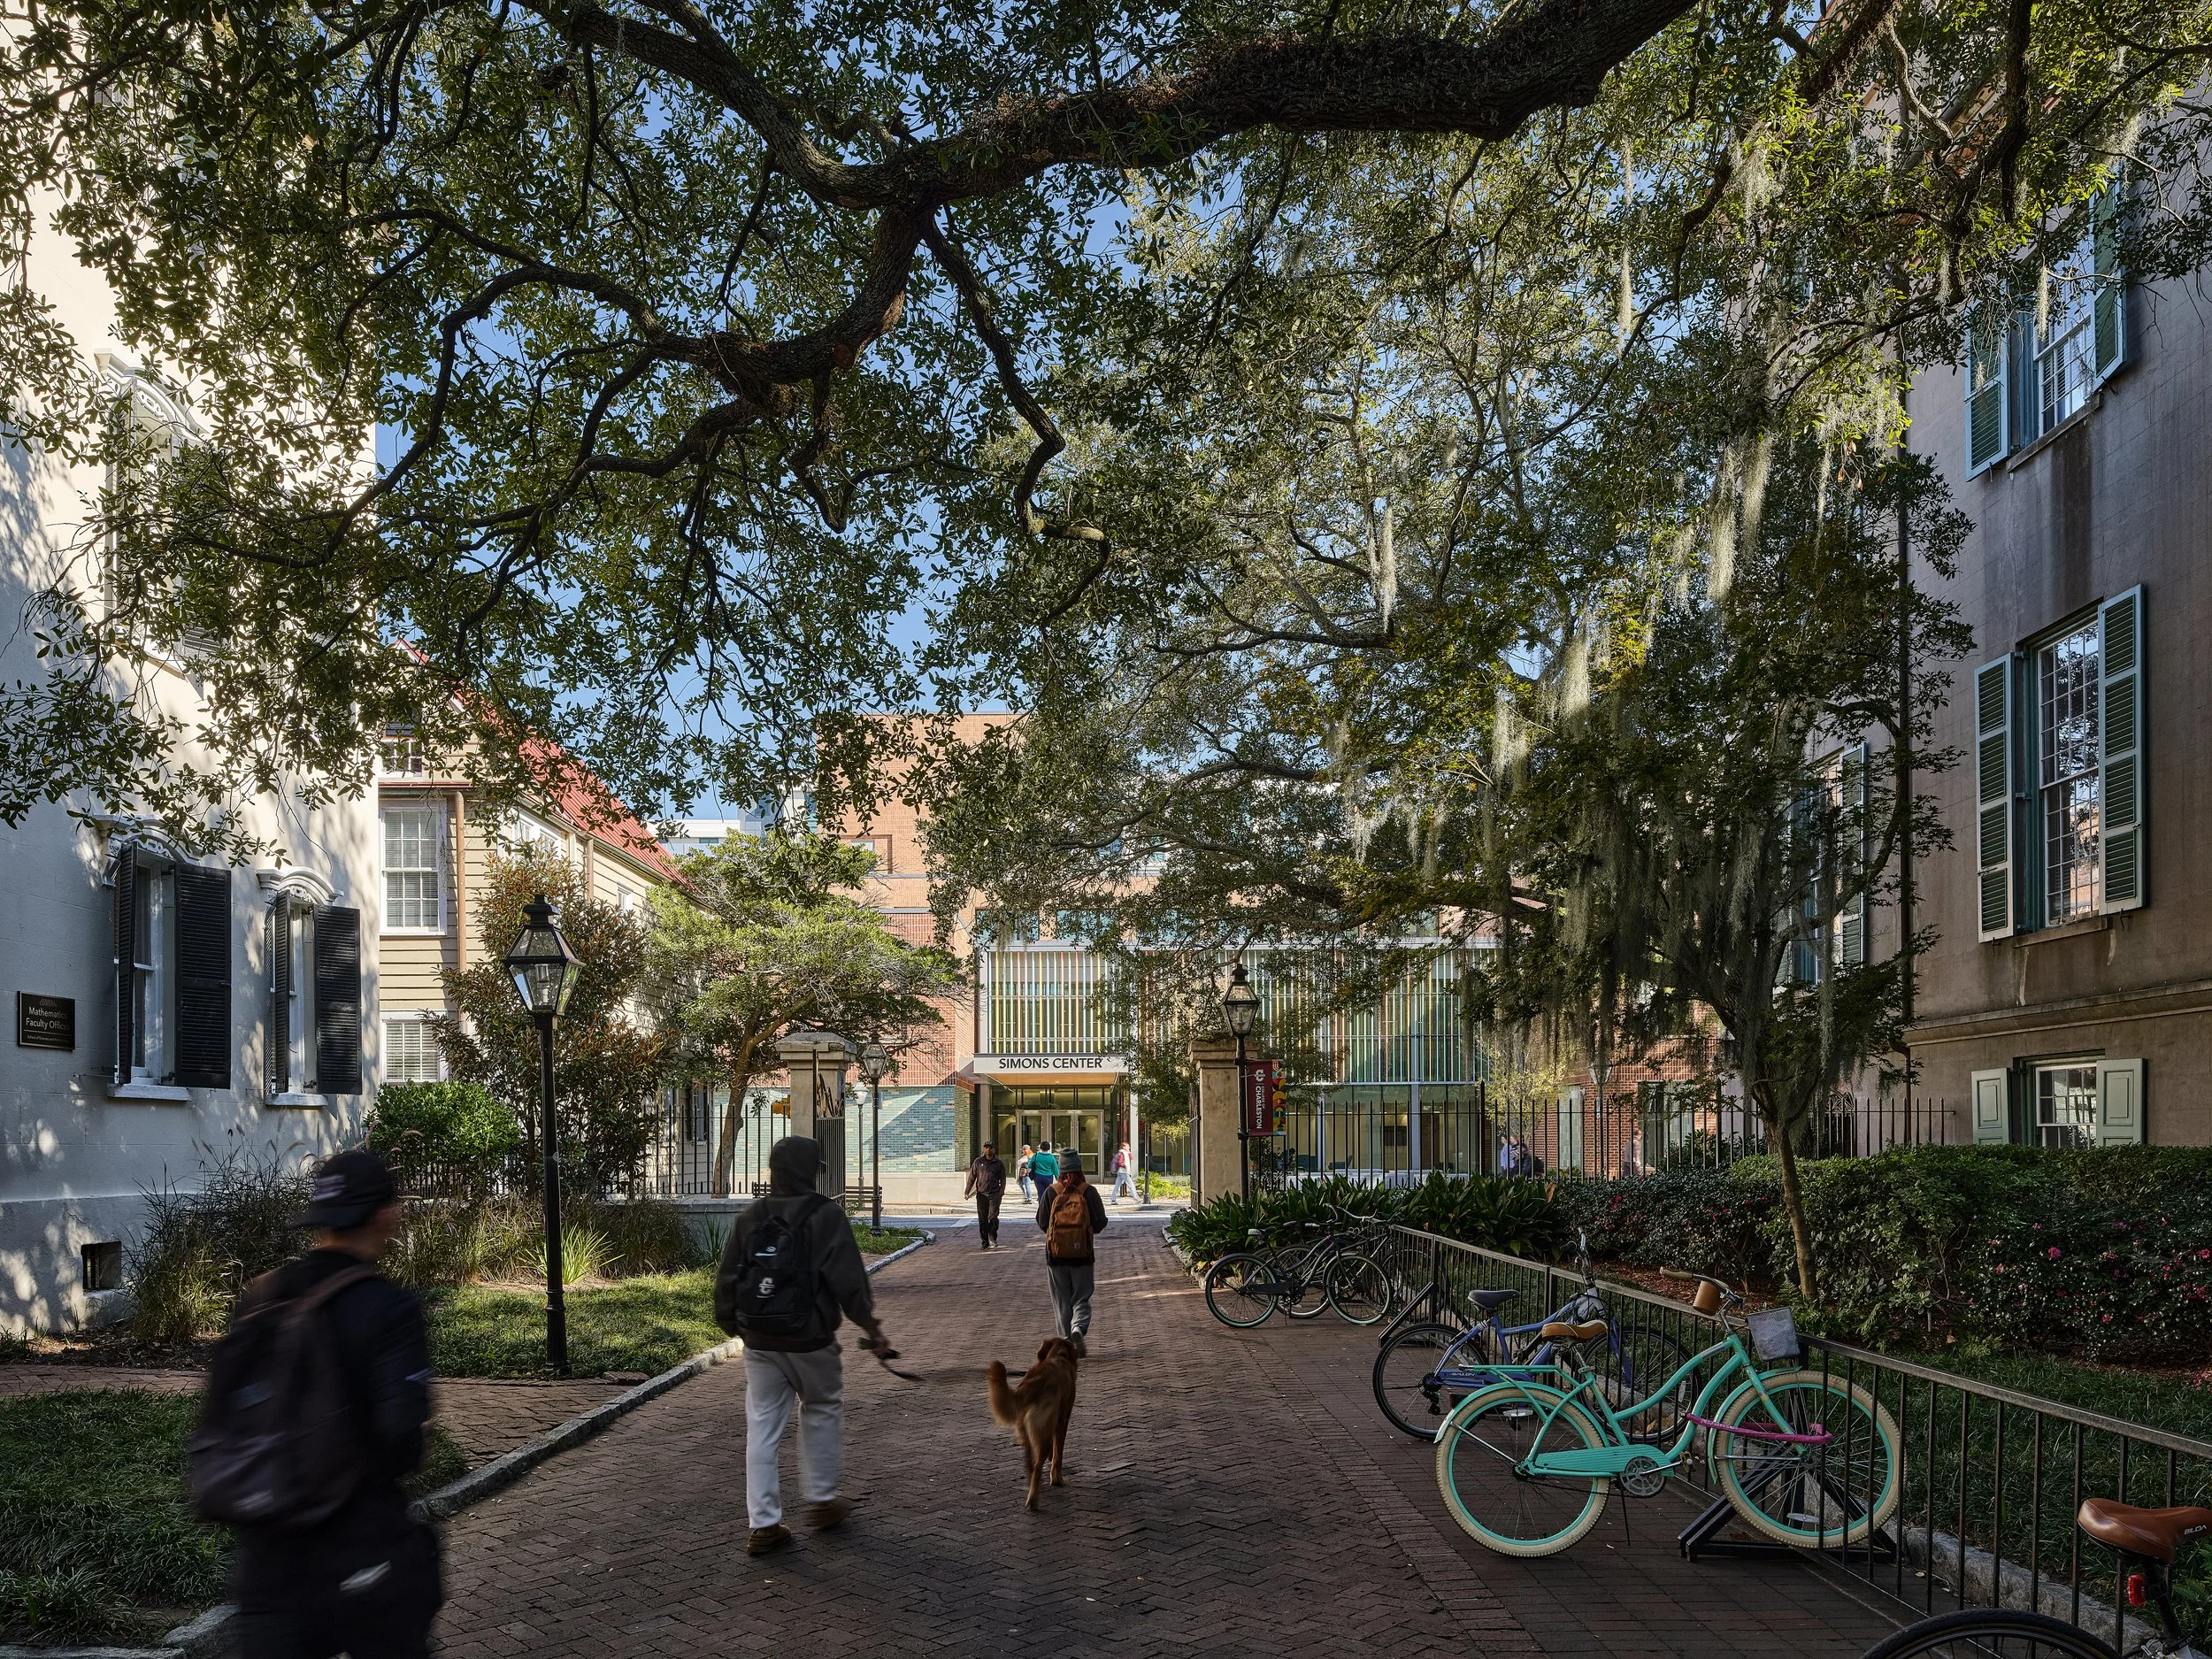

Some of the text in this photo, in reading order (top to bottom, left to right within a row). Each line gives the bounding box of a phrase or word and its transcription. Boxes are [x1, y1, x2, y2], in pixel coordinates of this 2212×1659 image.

[26, 1017, 48, 1030] Faculty
[999, 1058, 1102, 1069] SIMONS CENTER
